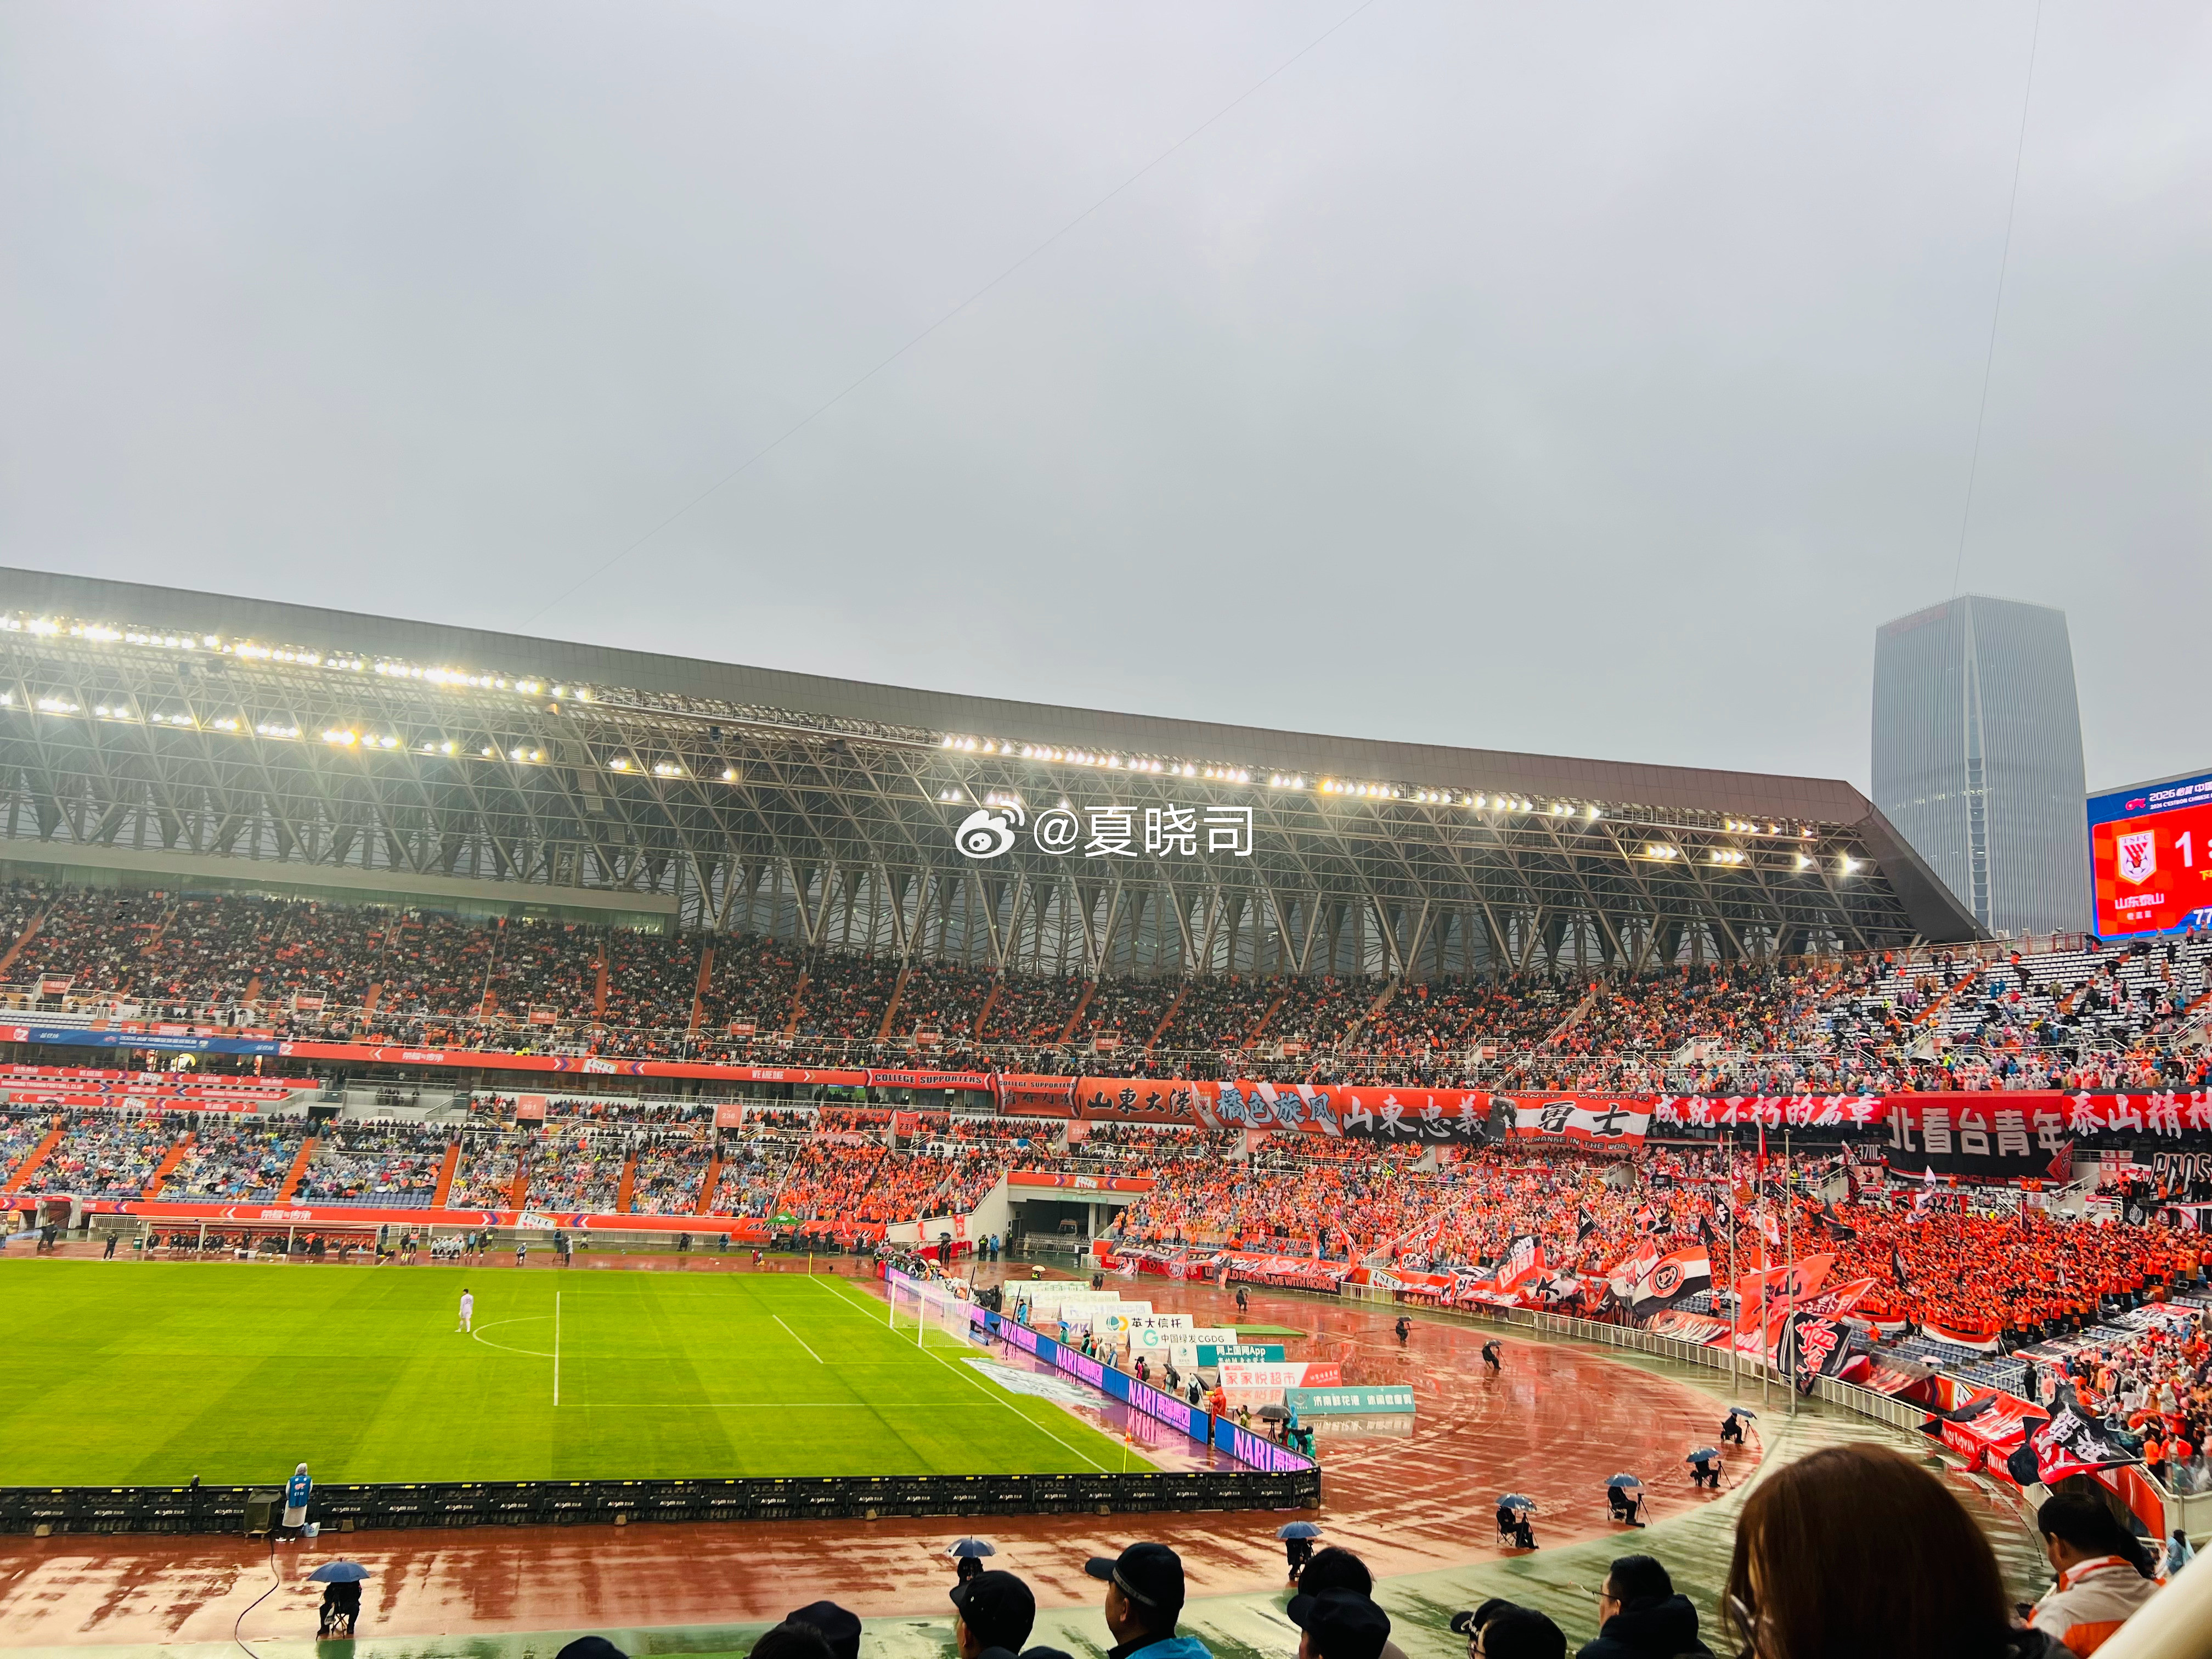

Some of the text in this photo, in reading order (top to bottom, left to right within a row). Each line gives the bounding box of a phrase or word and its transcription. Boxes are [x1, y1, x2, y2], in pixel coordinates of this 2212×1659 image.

[752, 1070, 784, 1080] WE ARE ONE
[875, 1074, 983, 1084] COLLEGE SUPPORTERS
[1215, 1088, 1339, 1124] 橘色旋风
[1578, 1093, 1650, 1102] WARRIOR
[1343, 1093, 1486, 1138] 山東忠義
[1538, 1101, 1630, 1138] 勇士
[1655, 1092, 1882, 1130] 成就不朽的篇章
[1886, 1105, 2066, 1156] 北看台青年
[1570, 1137, 1580, 1145] IN
[1584, 1141, 1604, 1150] THE
[1607, 1144, 1639, 1153] WORLD
[1122, 1242, 1210, 1260] CHAMON
[1268, 1275, 1284, 1286] LIVE
[1285, 1277, 1306, 1288] WITH
[1306, 1279, 1337, 1292] HONOR
[1373, 1271, 1399, 1288] TSFC
[1131, 1317, 1182, 1328] 英大信托
[1056, 1344, 1077, 1375] NARI
[1226, 1372, 1295, 1385] 家家悦超市
[1128, 1379, 1156, 1416] NARI
[1156, 1393, 1190, 1427] 南瑞集团
[1234, 1427, 1272, 1472] NARI
[1273, 1447, 1313, 1472] 南瑞集
